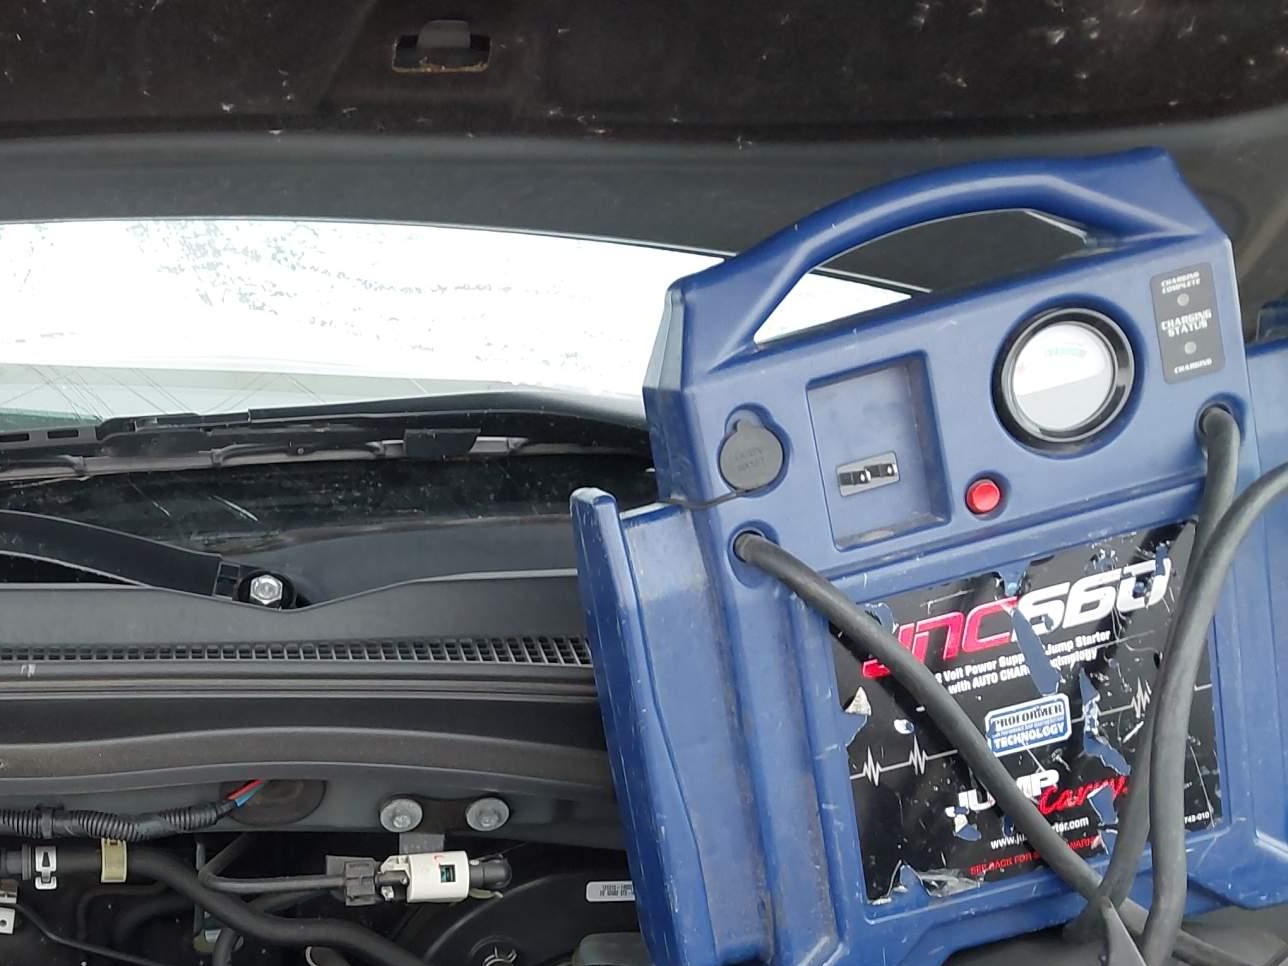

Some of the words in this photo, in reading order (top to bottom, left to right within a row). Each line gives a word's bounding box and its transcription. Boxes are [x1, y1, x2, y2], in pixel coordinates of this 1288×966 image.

[1161, 271, 1200, 288] CHARGING
[1162, 278, 1201, 295] COMPLETE
[1161, 308, 1212, 331] CHARGING
[1167, 319, 1208, 337] STATUS
[1174, 358, 1212, 374] CHARGING
[943, 667, 963, 682] Volt
[965, 660, 997, 677] Power
[998, 653, 1026, 669] Supp
[1045, 640, 1074, 656] Jump
[1075, 630, 1111, 647] Starter
[948, 680, 971, 695] with
[972, 673, 998, 690] AUTO
[999, 665, 1030, 681] CHAR
[994, 722, 1065, 750] TECHNOLOGY
